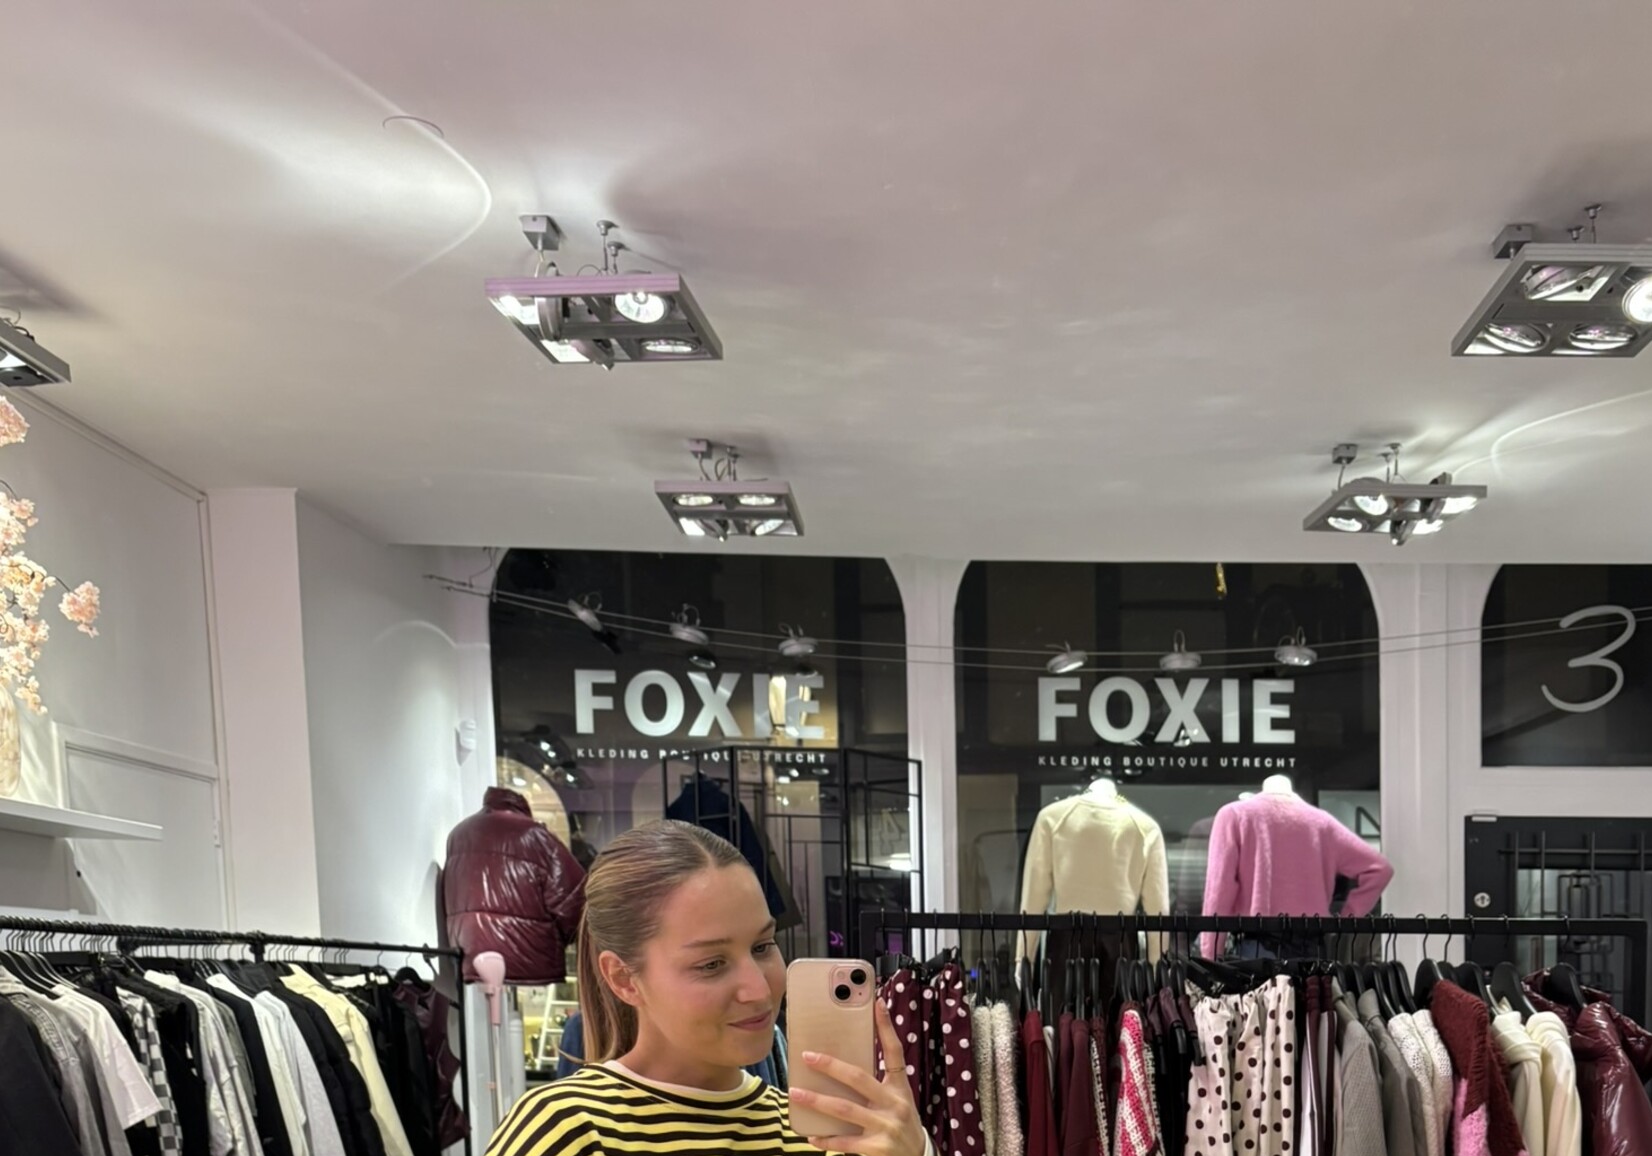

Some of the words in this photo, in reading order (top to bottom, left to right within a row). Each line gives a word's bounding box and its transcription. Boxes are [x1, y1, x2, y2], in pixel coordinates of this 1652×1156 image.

[1541, 604, 1637, 713] 3
[574, 669, 825, 740] FOXIE
[1037, 676, 1296, 744] FOXIE
[576, 749, 649, 761] KLEDING
[1038, 756, 1112, 767] KLEDING
[1123, 756, 1209, 768] BOUTIQUE
[1220, 757, 1296, 768] UTRECHT
